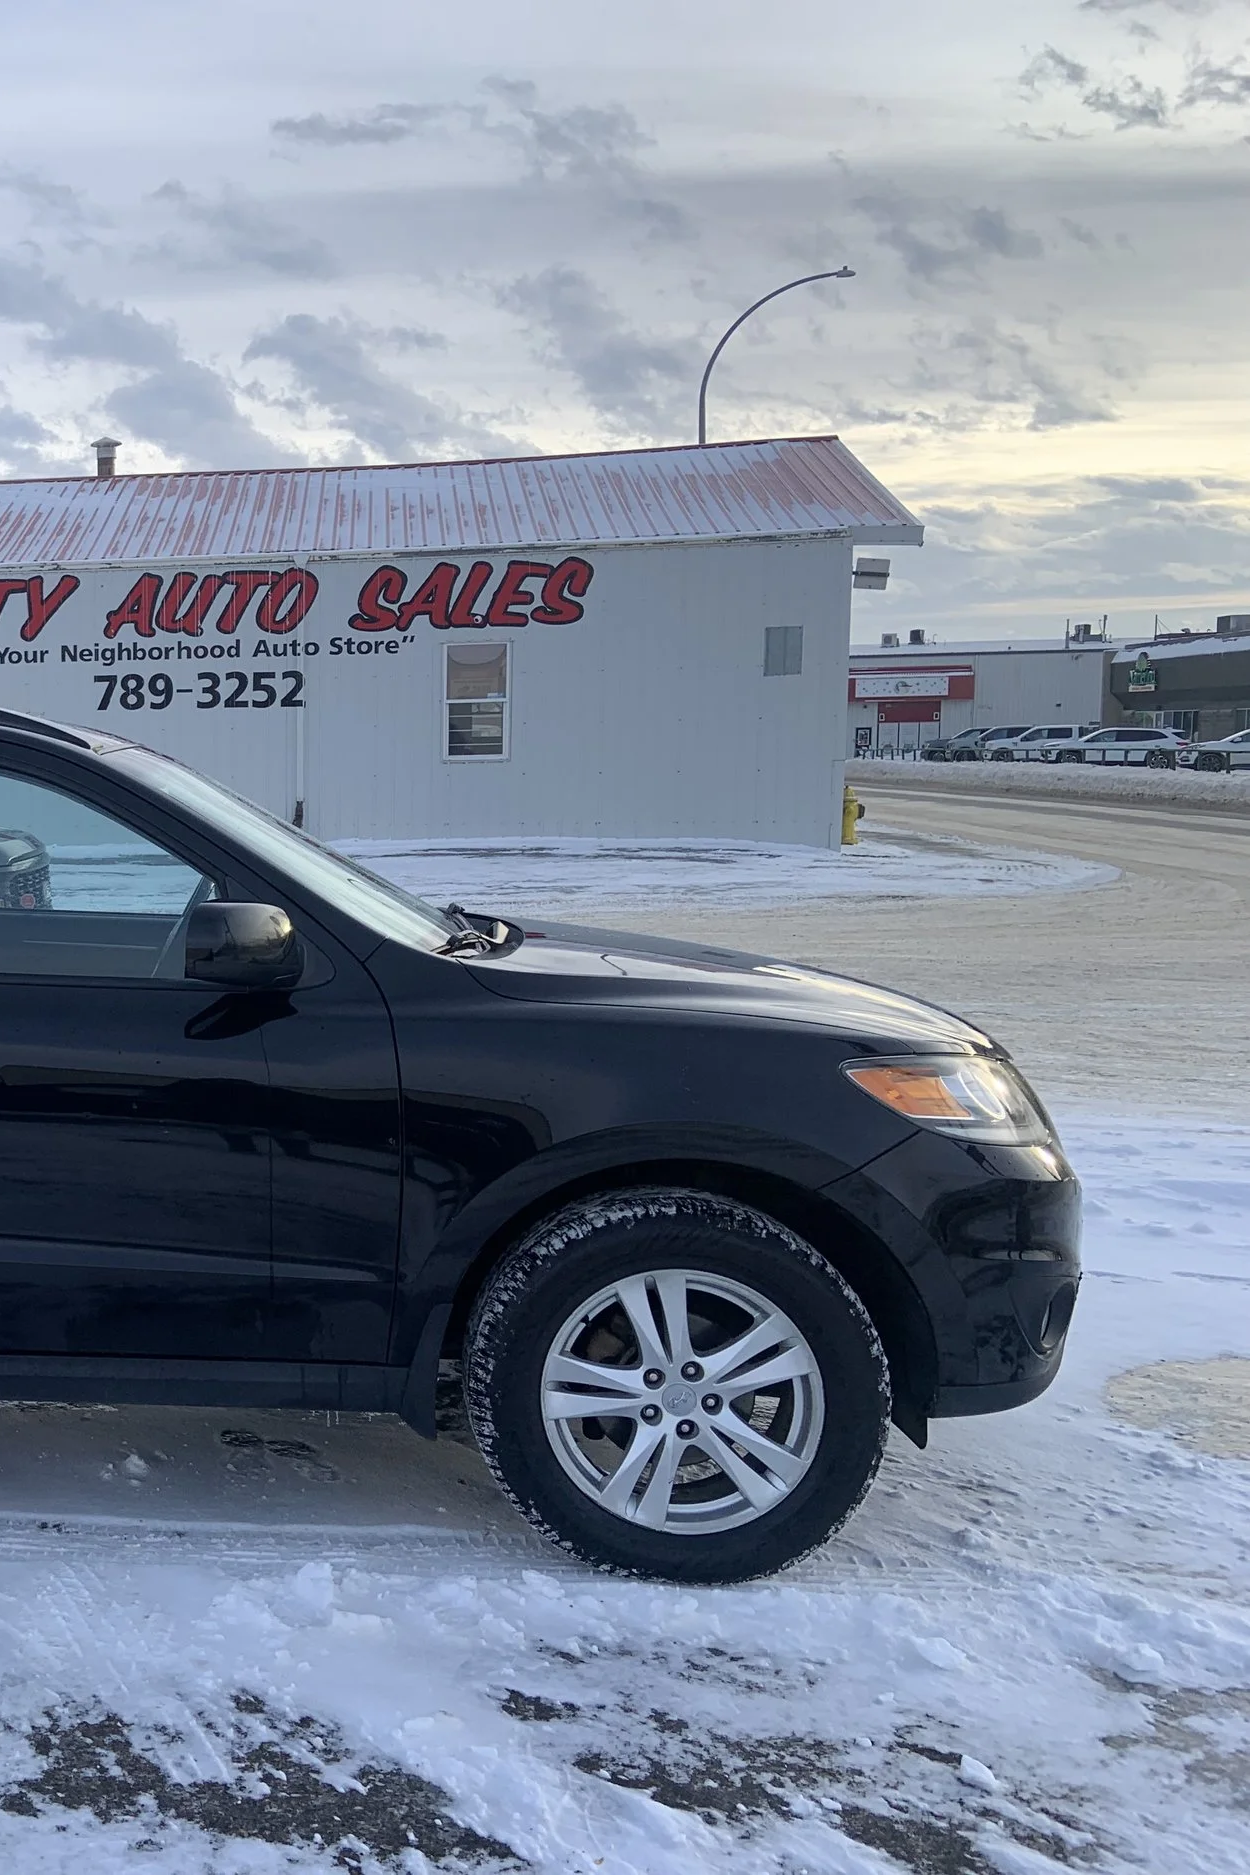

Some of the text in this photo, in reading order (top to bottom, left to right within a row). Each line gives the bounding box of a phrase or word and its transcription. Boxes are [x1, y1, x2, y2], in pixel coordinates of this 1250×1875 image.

[103, 567, 319, 639] AUTO
[348, 556, 594, 632] SALES
[61, 640, 241, 666] Neighborhood
[252, 639, 320, 657] Auto
[329, 635, 415, 656] Store"
[94, 670, 306, 711] 789-3252
